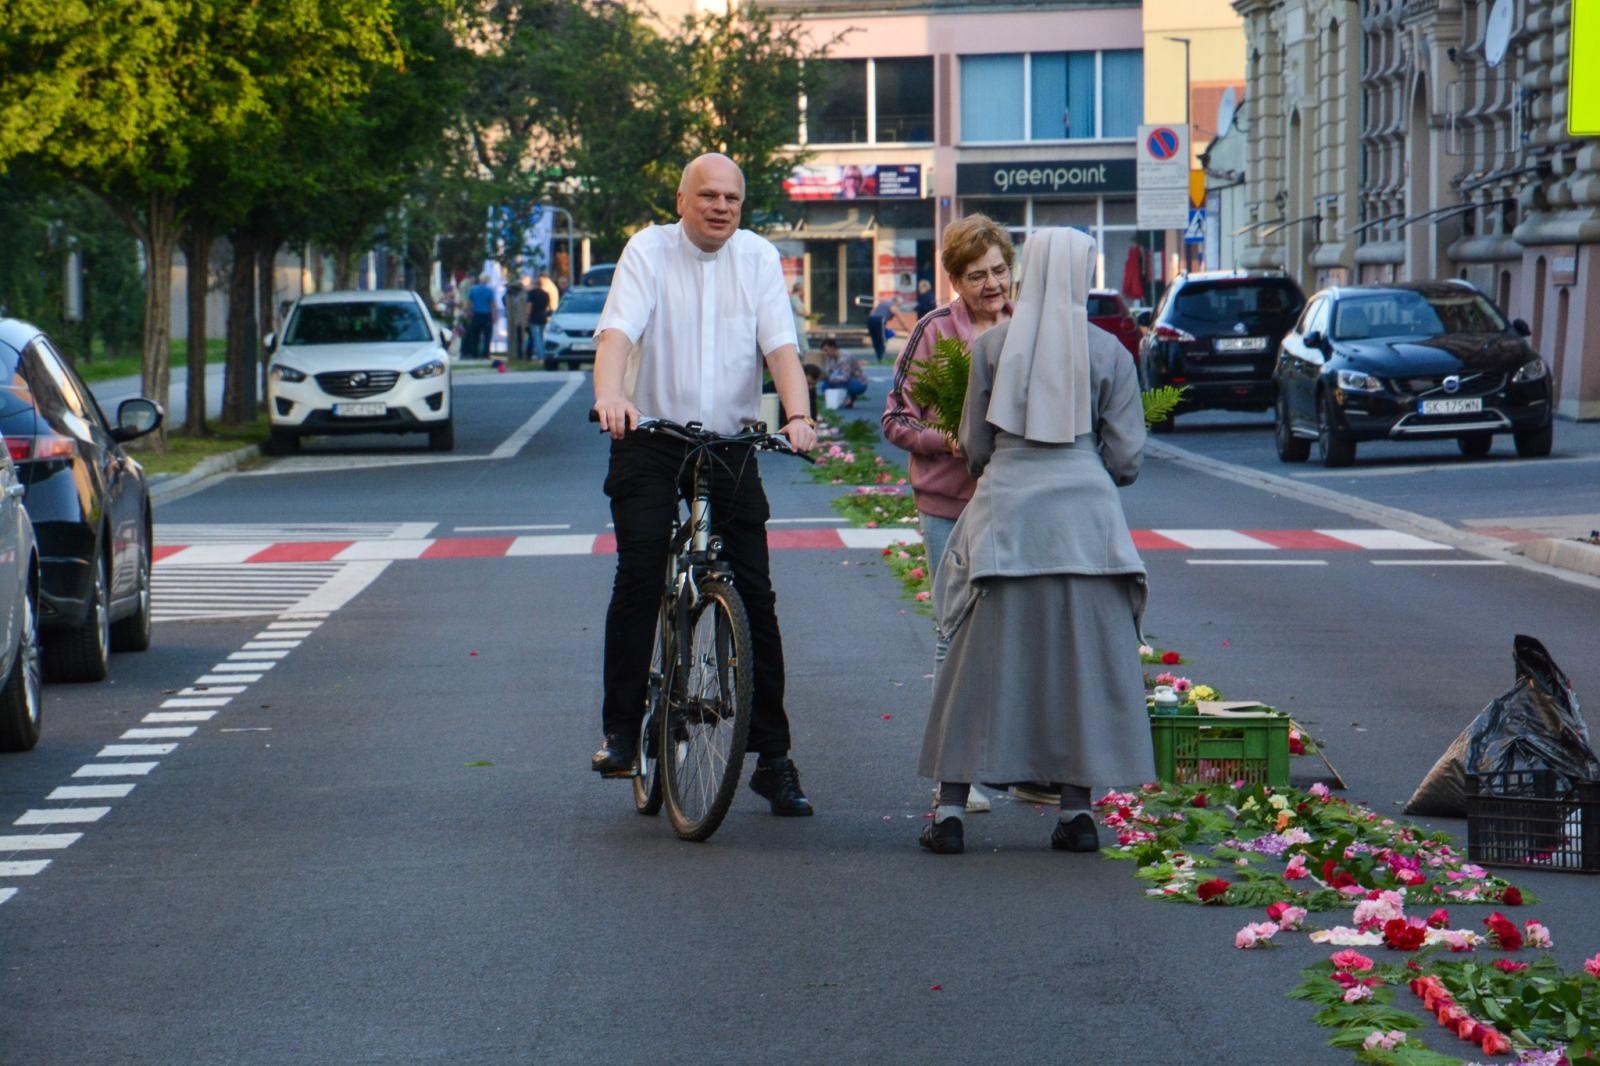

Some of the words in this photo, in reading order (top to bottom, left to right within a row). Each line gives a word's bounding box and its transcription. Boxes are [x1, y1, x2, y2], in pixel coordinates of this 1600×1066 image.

[994, 163, 1106, 192] greenpoint
[1425, 400, 1440, 414] SK
[1445, 398, 1480, 413] 175WN
